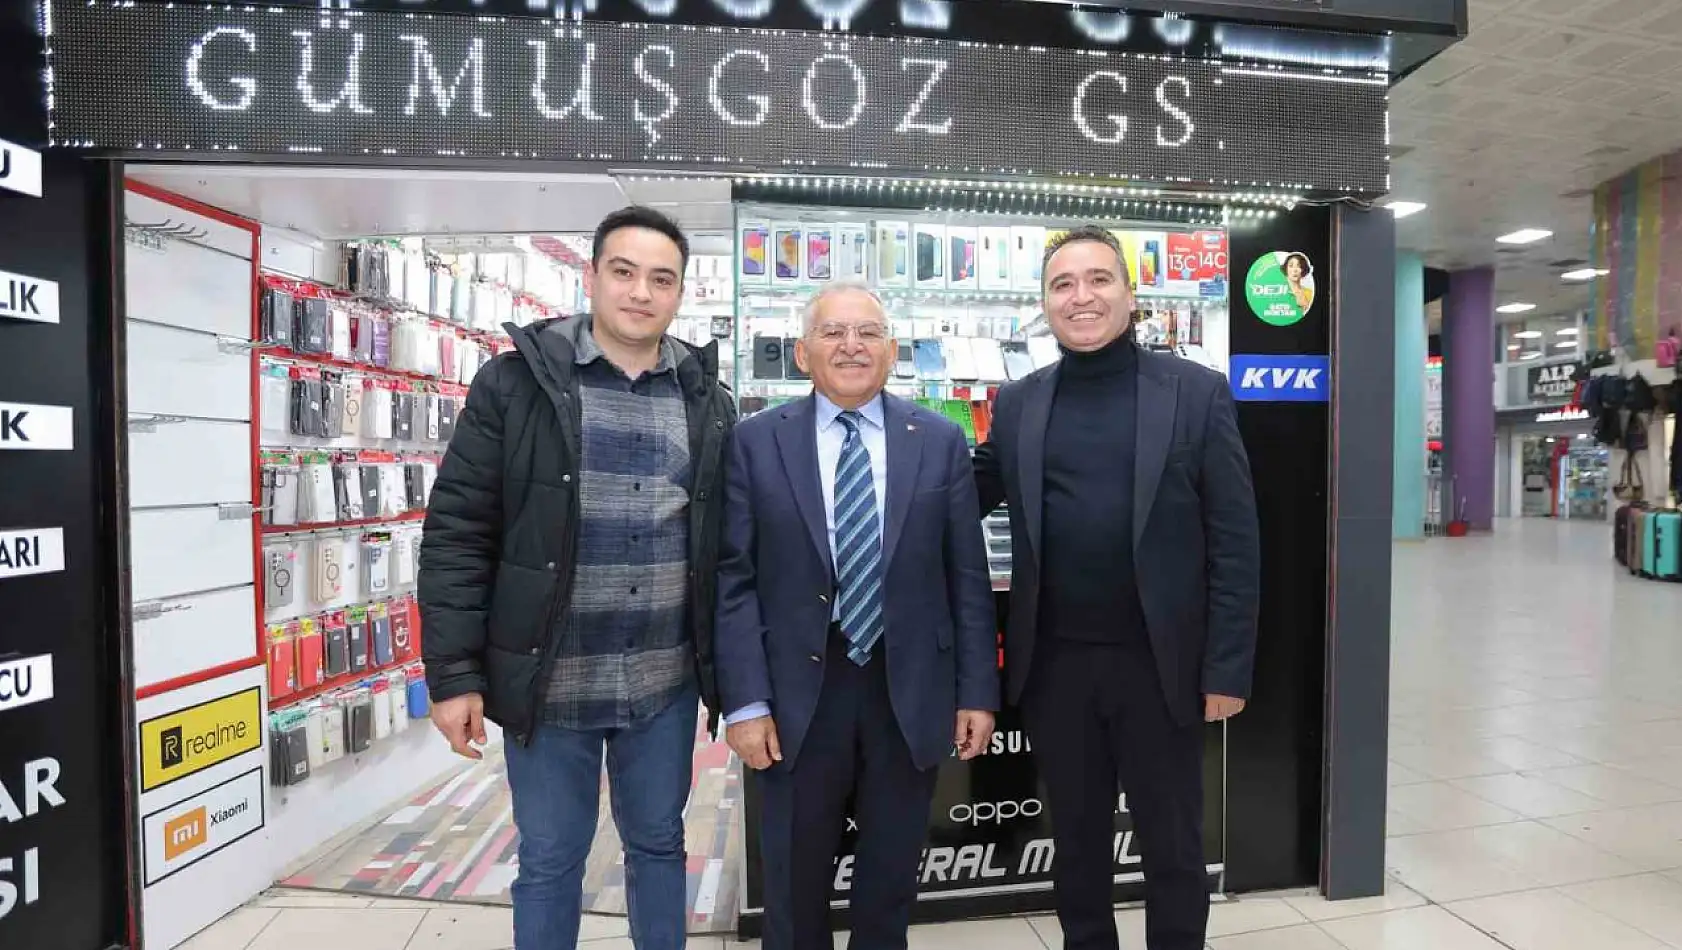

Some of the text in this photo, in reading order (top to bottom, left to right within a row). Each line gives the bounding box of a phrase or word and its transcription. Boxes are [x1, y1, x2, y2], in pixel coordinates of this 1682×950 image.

[185, 19, 953, 147] GÜMÜŞGÖZ
[1169, 254, 1196, 271] 13C
[1197, 252, 1227, 269] 14C
[1241, 367, 1322, 389] KVK
[1538, 364, 1576, 383] ALP
[1, 409, 30, 441] K
[0, 665, 32, 702] CU
[186, 721, 247, 757] realme
[210, 798, 249, 828] Xiaomi
[949, 798, 1042, 827] oppo
